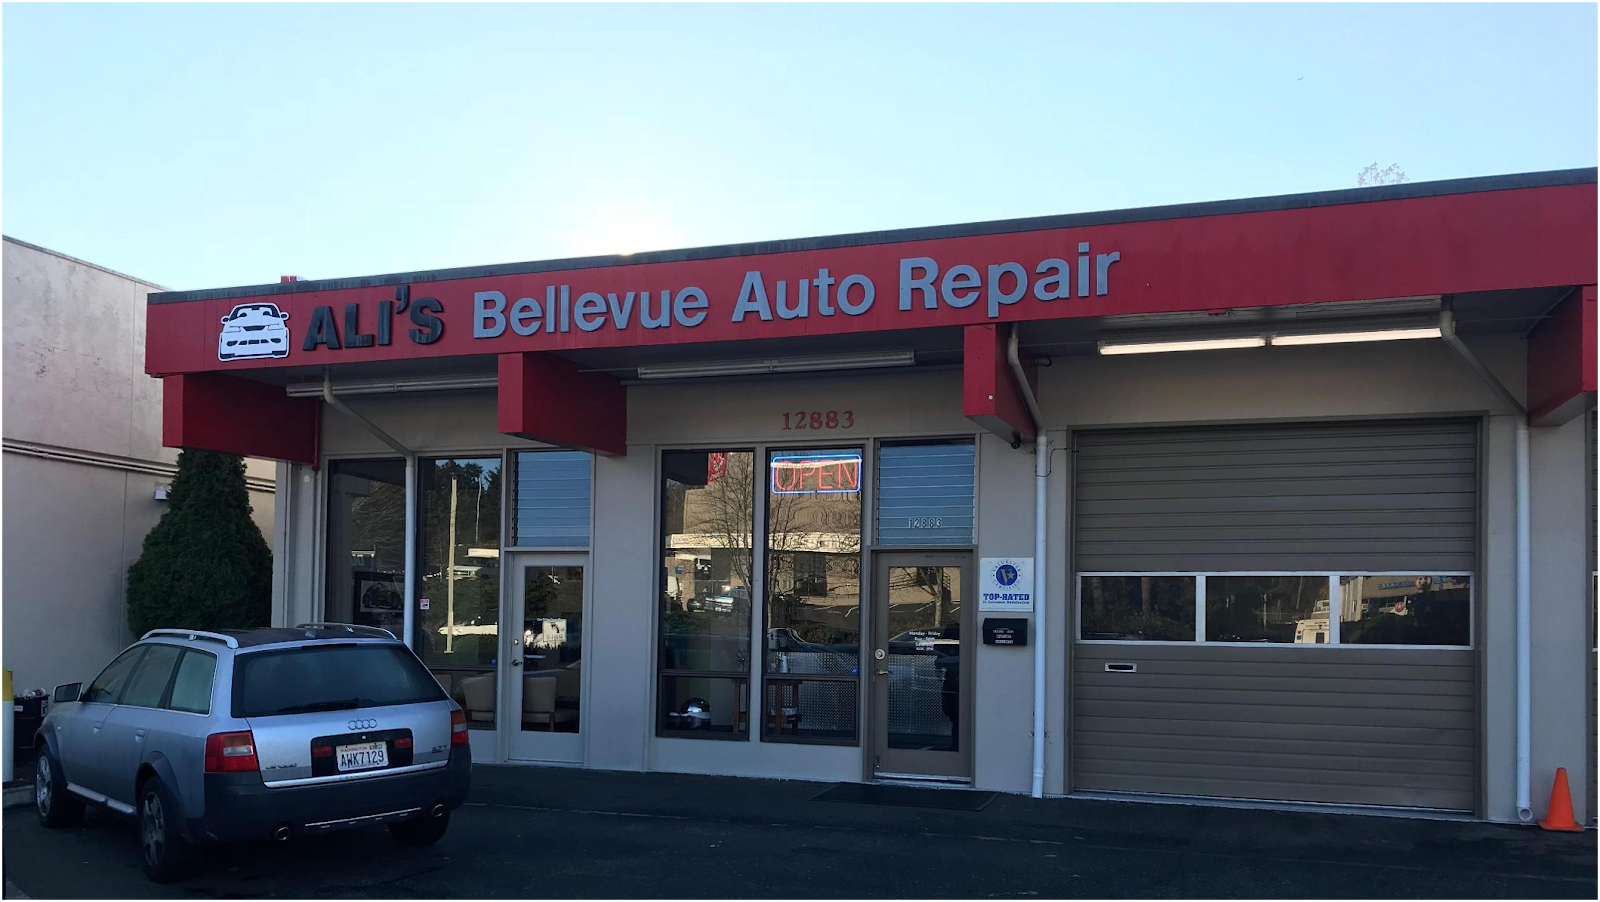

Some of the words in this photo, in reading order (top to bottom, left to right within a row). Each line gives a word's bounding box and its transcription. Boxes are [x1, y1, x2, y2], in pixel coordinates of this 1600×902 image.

[302, 285, 444, 351] ALI'S
[473, 285, 709, 339] Bellevue
[731, 268, 876, 322] Auto
[899, 242, 1121, 318] Repair
[782, 410, 855, 431] 12883
[775, 459, 858, 490] OPEN
[908, 517, 942, 529] 12883
[982, 593, 1030, 601] TOP-RATED
[341, 750, 385, 768] AWK7129
